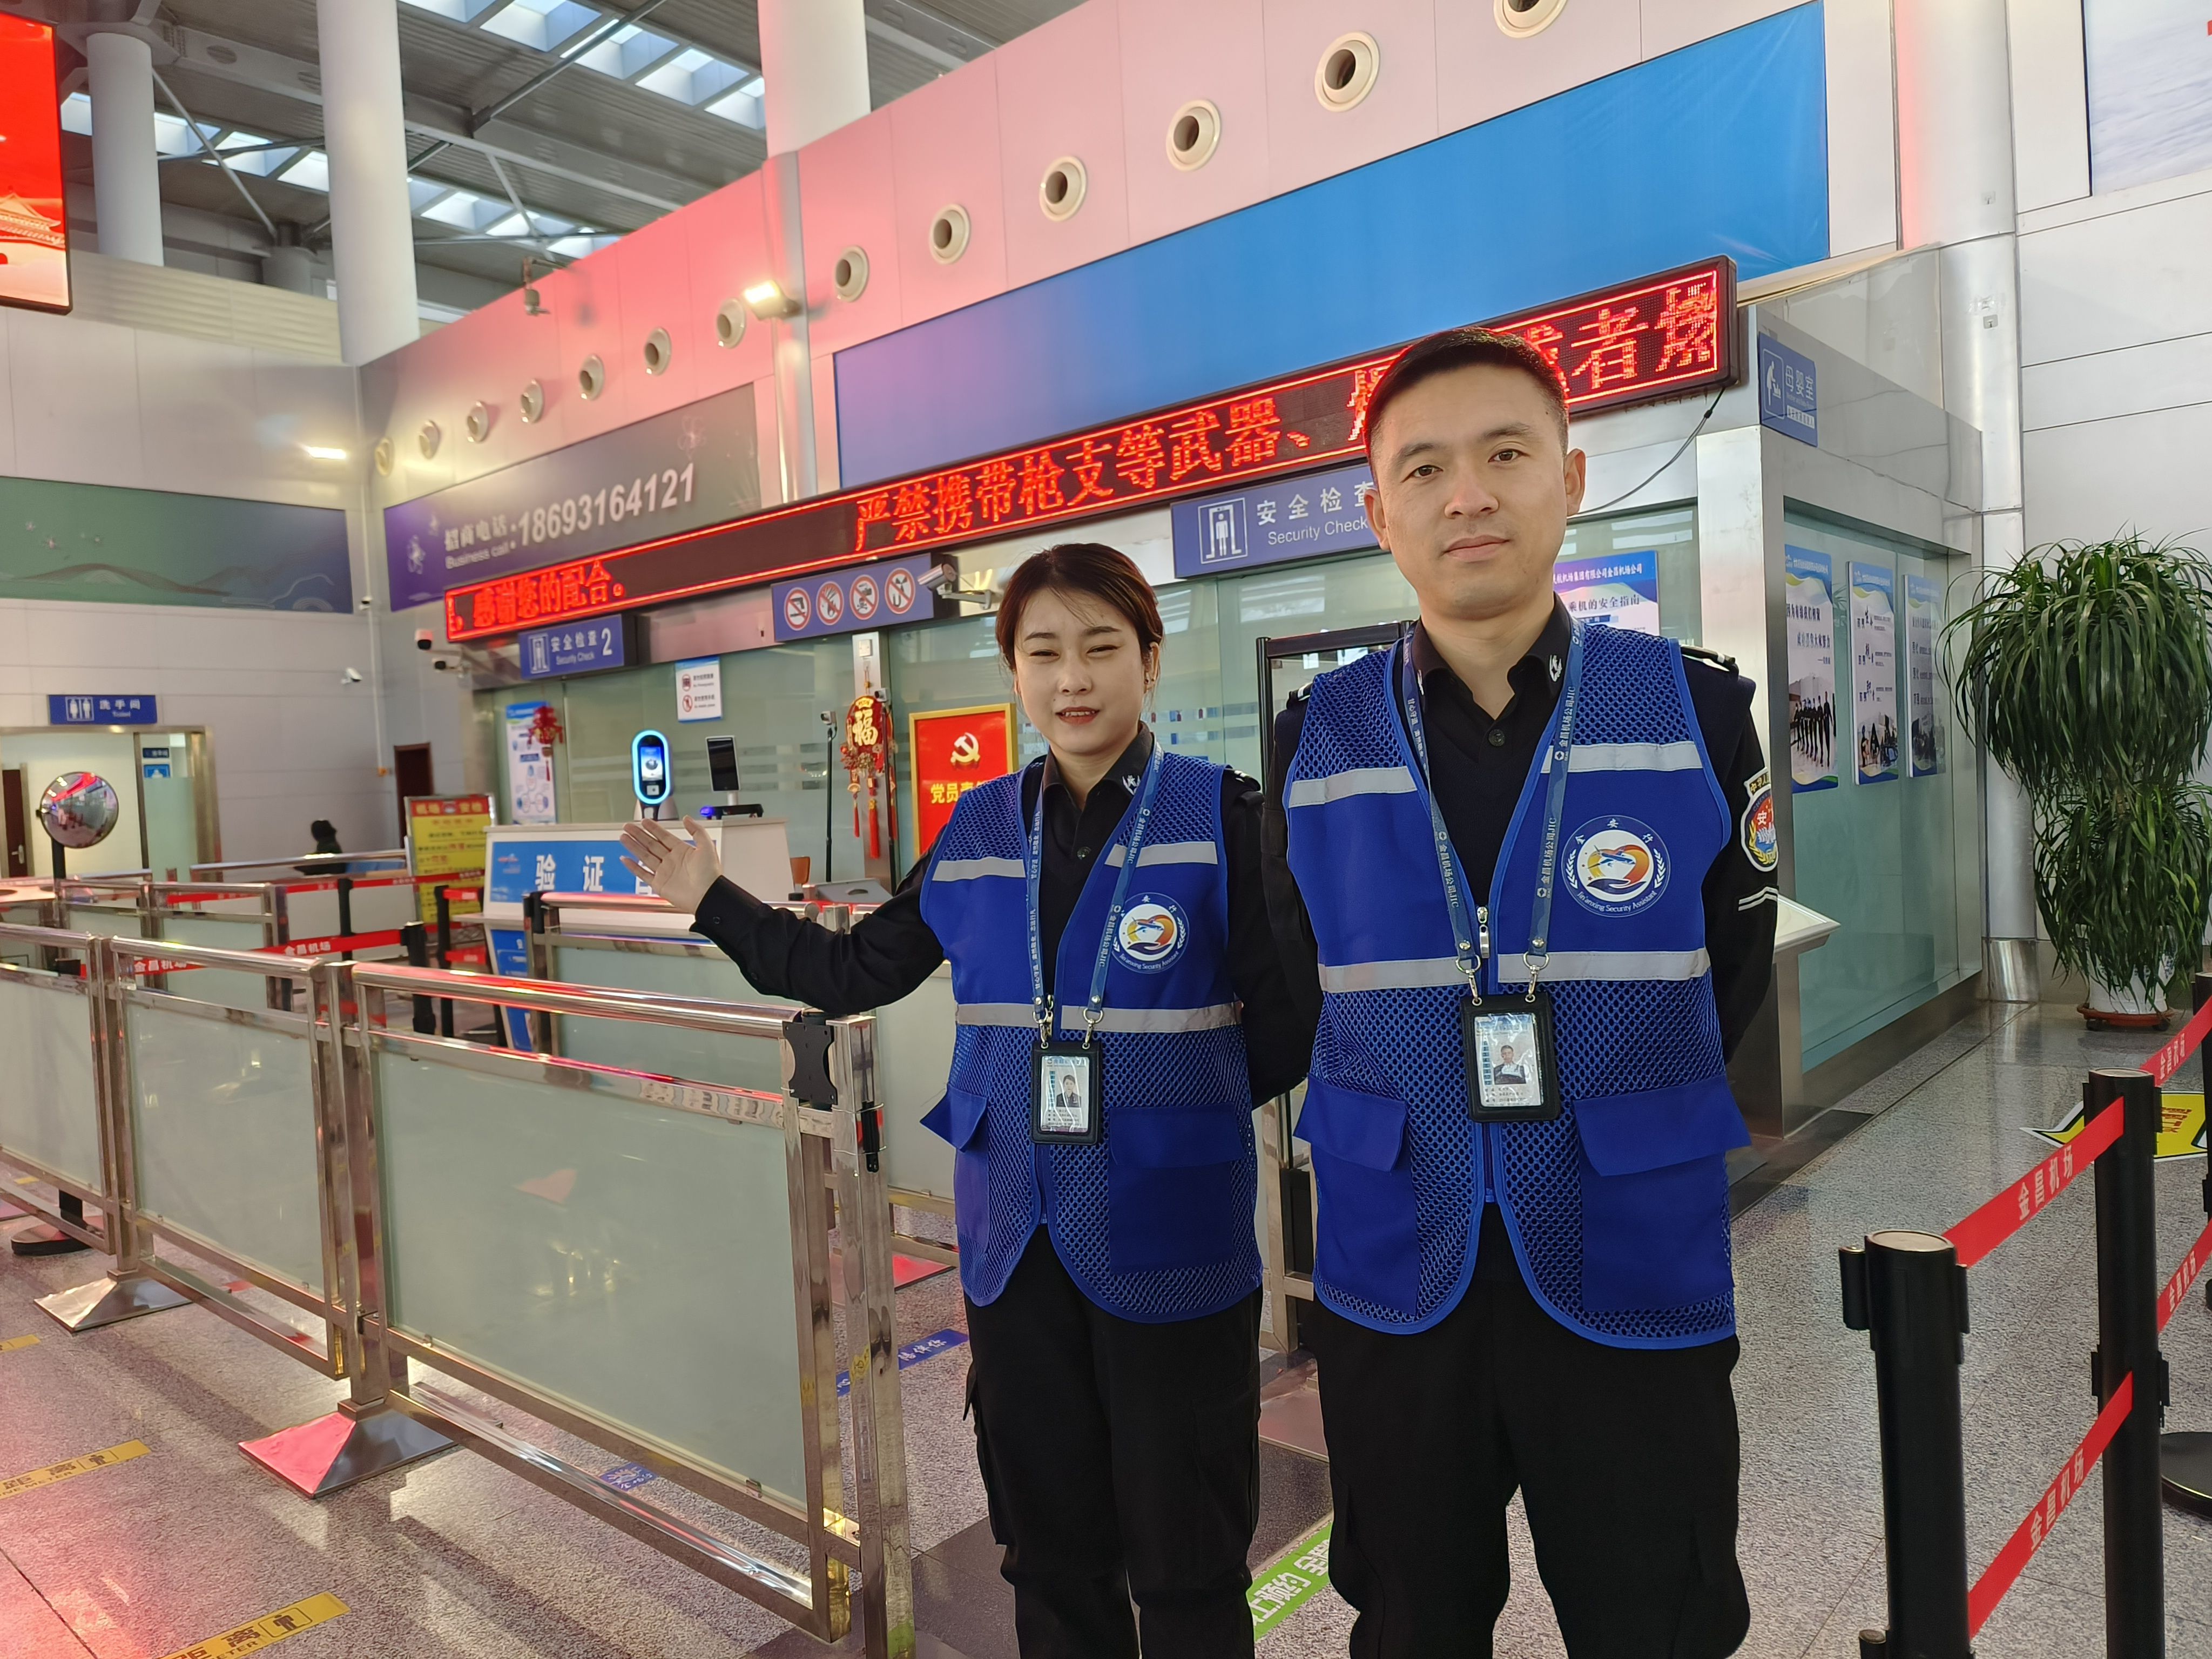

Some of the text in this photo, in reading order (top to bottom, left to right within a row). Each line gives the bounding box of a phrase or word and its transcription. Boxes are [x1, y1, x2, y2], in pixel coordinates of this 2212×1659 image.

[1785, 365, 1814, 401] 母婴室
[517, 463, 695, 546] 18693164121
[1267, 517, 1368, 545] Security Check
[444, 546, 490, 569] Business
[601, 628, 613, 656] 2
[852, 709, 879, 746] 福
[1540, 817, 1556, 885] 金昌机场公司JIC
[1439, 844, 1459, 908] 金昌机场公司JIC
[1632, 890, 1658, 907] Assistant
[284, 941, 331, 956] 金昌机场
[2160, 1033, 2186, 1080] 金昌机场
[2018, 1143, 2073, 1222] 金昌机场
[0, 1485, 24, 1496] NE
[2030, 1447, 2086, 1553] 金昌机场
